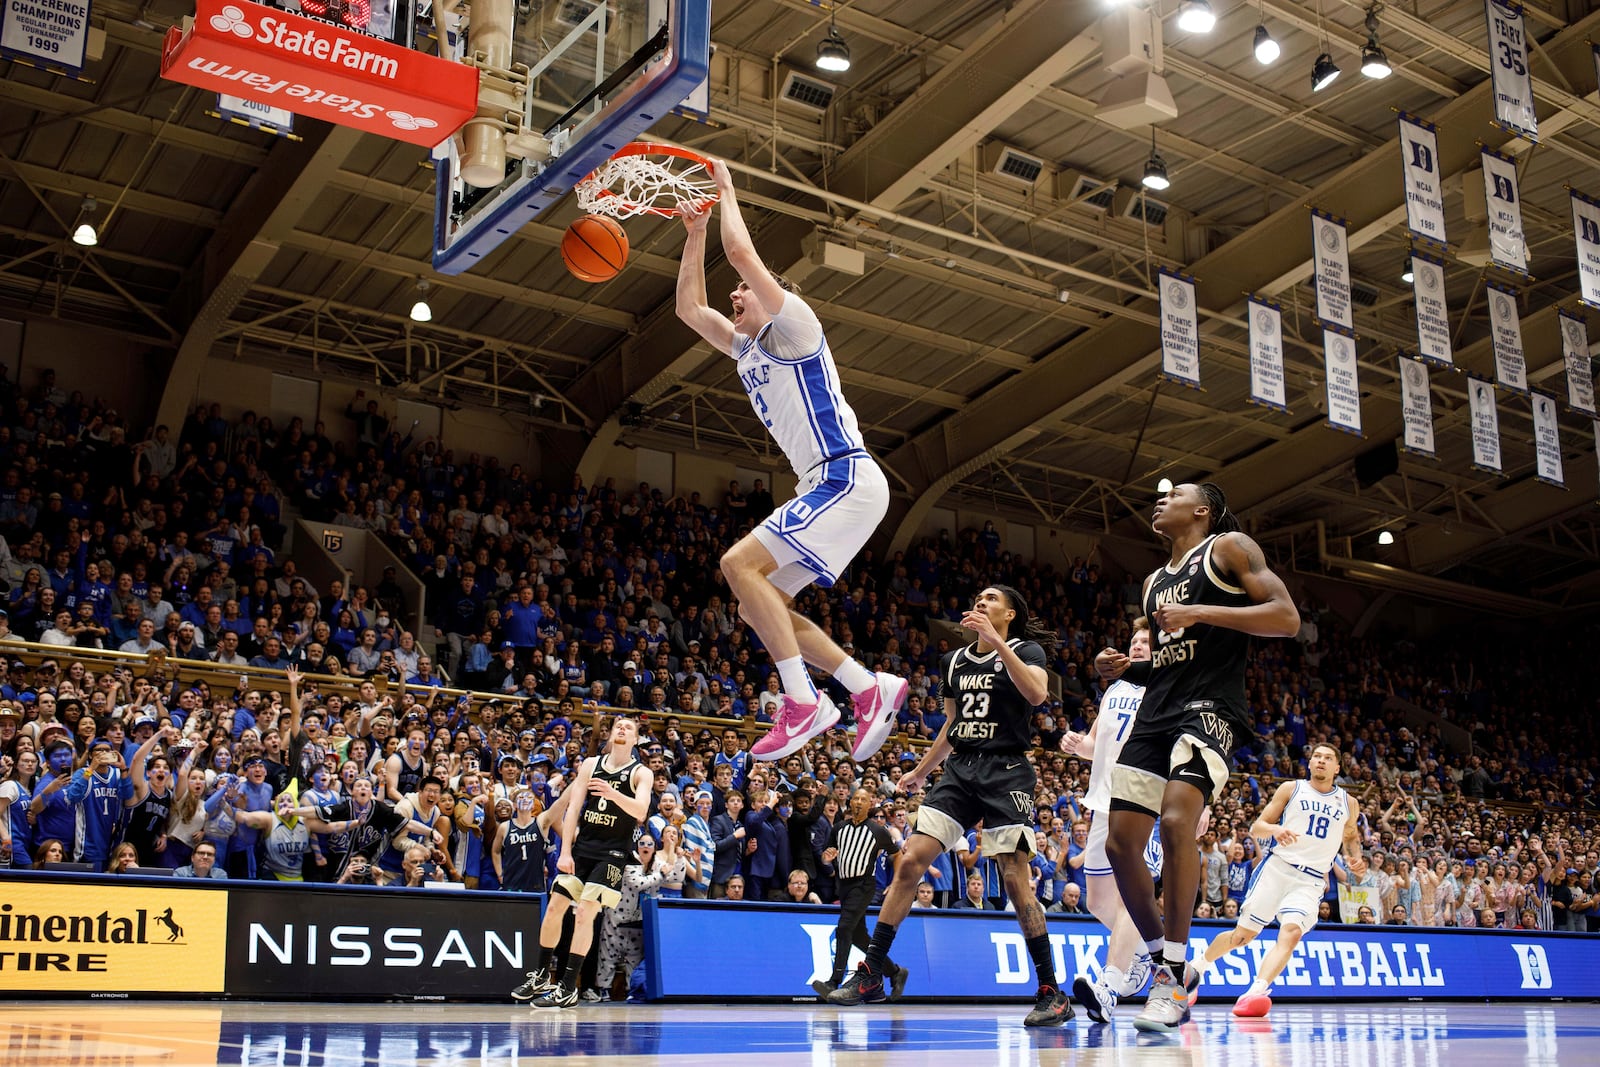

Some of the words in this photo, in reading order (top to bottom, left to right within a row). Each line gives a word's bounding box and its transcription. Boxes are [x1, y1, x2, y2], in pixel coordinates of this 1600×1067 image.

[12, 1, 81, 30] CHAMPIONS
[28, 0, 86, 18] ERENCE
[16, 15, 47, 30] REGULAR
[48, 24, 75, 37] SEASON
[21, 25, 67, 42] TOURNAMENT
[28, 35, 60, 53] 1999
[1498, 40, 1526, 76] 35
[242, 99, 272, 114] 2000
[1416, 180, 1433, 193] NCAA
[1408, 191, 1426, 206] FINAL
[1426, 199, 1442, 211] FOUR
[1498, 211, 1514, 223] NCAA
[1321, 256, 1344, 273] ATLANTIC
[1324, 267, 1341, 279] COAST
[1318, 274, 1350, 292] CONFERENCE
[1320, 284, 1349, 302] CHAMPIONS
[1421, 295, 1442, 310] ATLANTIC
[1425, 306, 1440, 317] COAST
[1167, 313, 1192, 328] ATLANTIC
[1419, 313, 1449, 329] CONFERENCE
[1172, 323, 1189, 335] COAST
[1421, 322, 1449, 338] CHAMPIONS
[1163, 330, 1197, 347] CONFERENCE
[1165, 340, 1196, 356] CHAMPIONS
[1256, 341, 1279, 355] ATLANTIC
[1252, 358, 1283, 373] CONFERENCE
[1332, 367, 1354, 380] ATLANTIC
[741, 364, 771, 394] UKE
[1254, 366, 1282, 382] CHAMPIONS
[1336, 376, 1351, 387] COAST
[1329, 383, 1359, 398] CONFERENCE
[1330, 392, 1358, 406] CHAMPIONS
[755, 391, 773, 429] 2
[327, 535, 341, 550] 15
[1155, 578, 1191, 610] WAKE
[959, 673, 996, 691] WAKE
[961, 691, 990, 719] 23
[1107, 696, 1143, 711] DUK
[1115, 712, 1132, 742] 7
[93, 787, 117, 799] DUKE
[102, 798, 109, 816] 1
[597, 796, 608, 812] 6
[1299, 799, 1344, 822] DUKE
[584, 810, 618, 828] FOREST
[1305, 813, 1330, 840] 18
[508, 832, 538, 846] Duke
[520, 845, 528, 861] 1
[248, 922, 524, 969] NISSAN
[990, 932, 1111, 984] DUK
[1188, 937, 1445, 987] ASETBALL
[91, 991, 129, 999] DAKTRONICS
